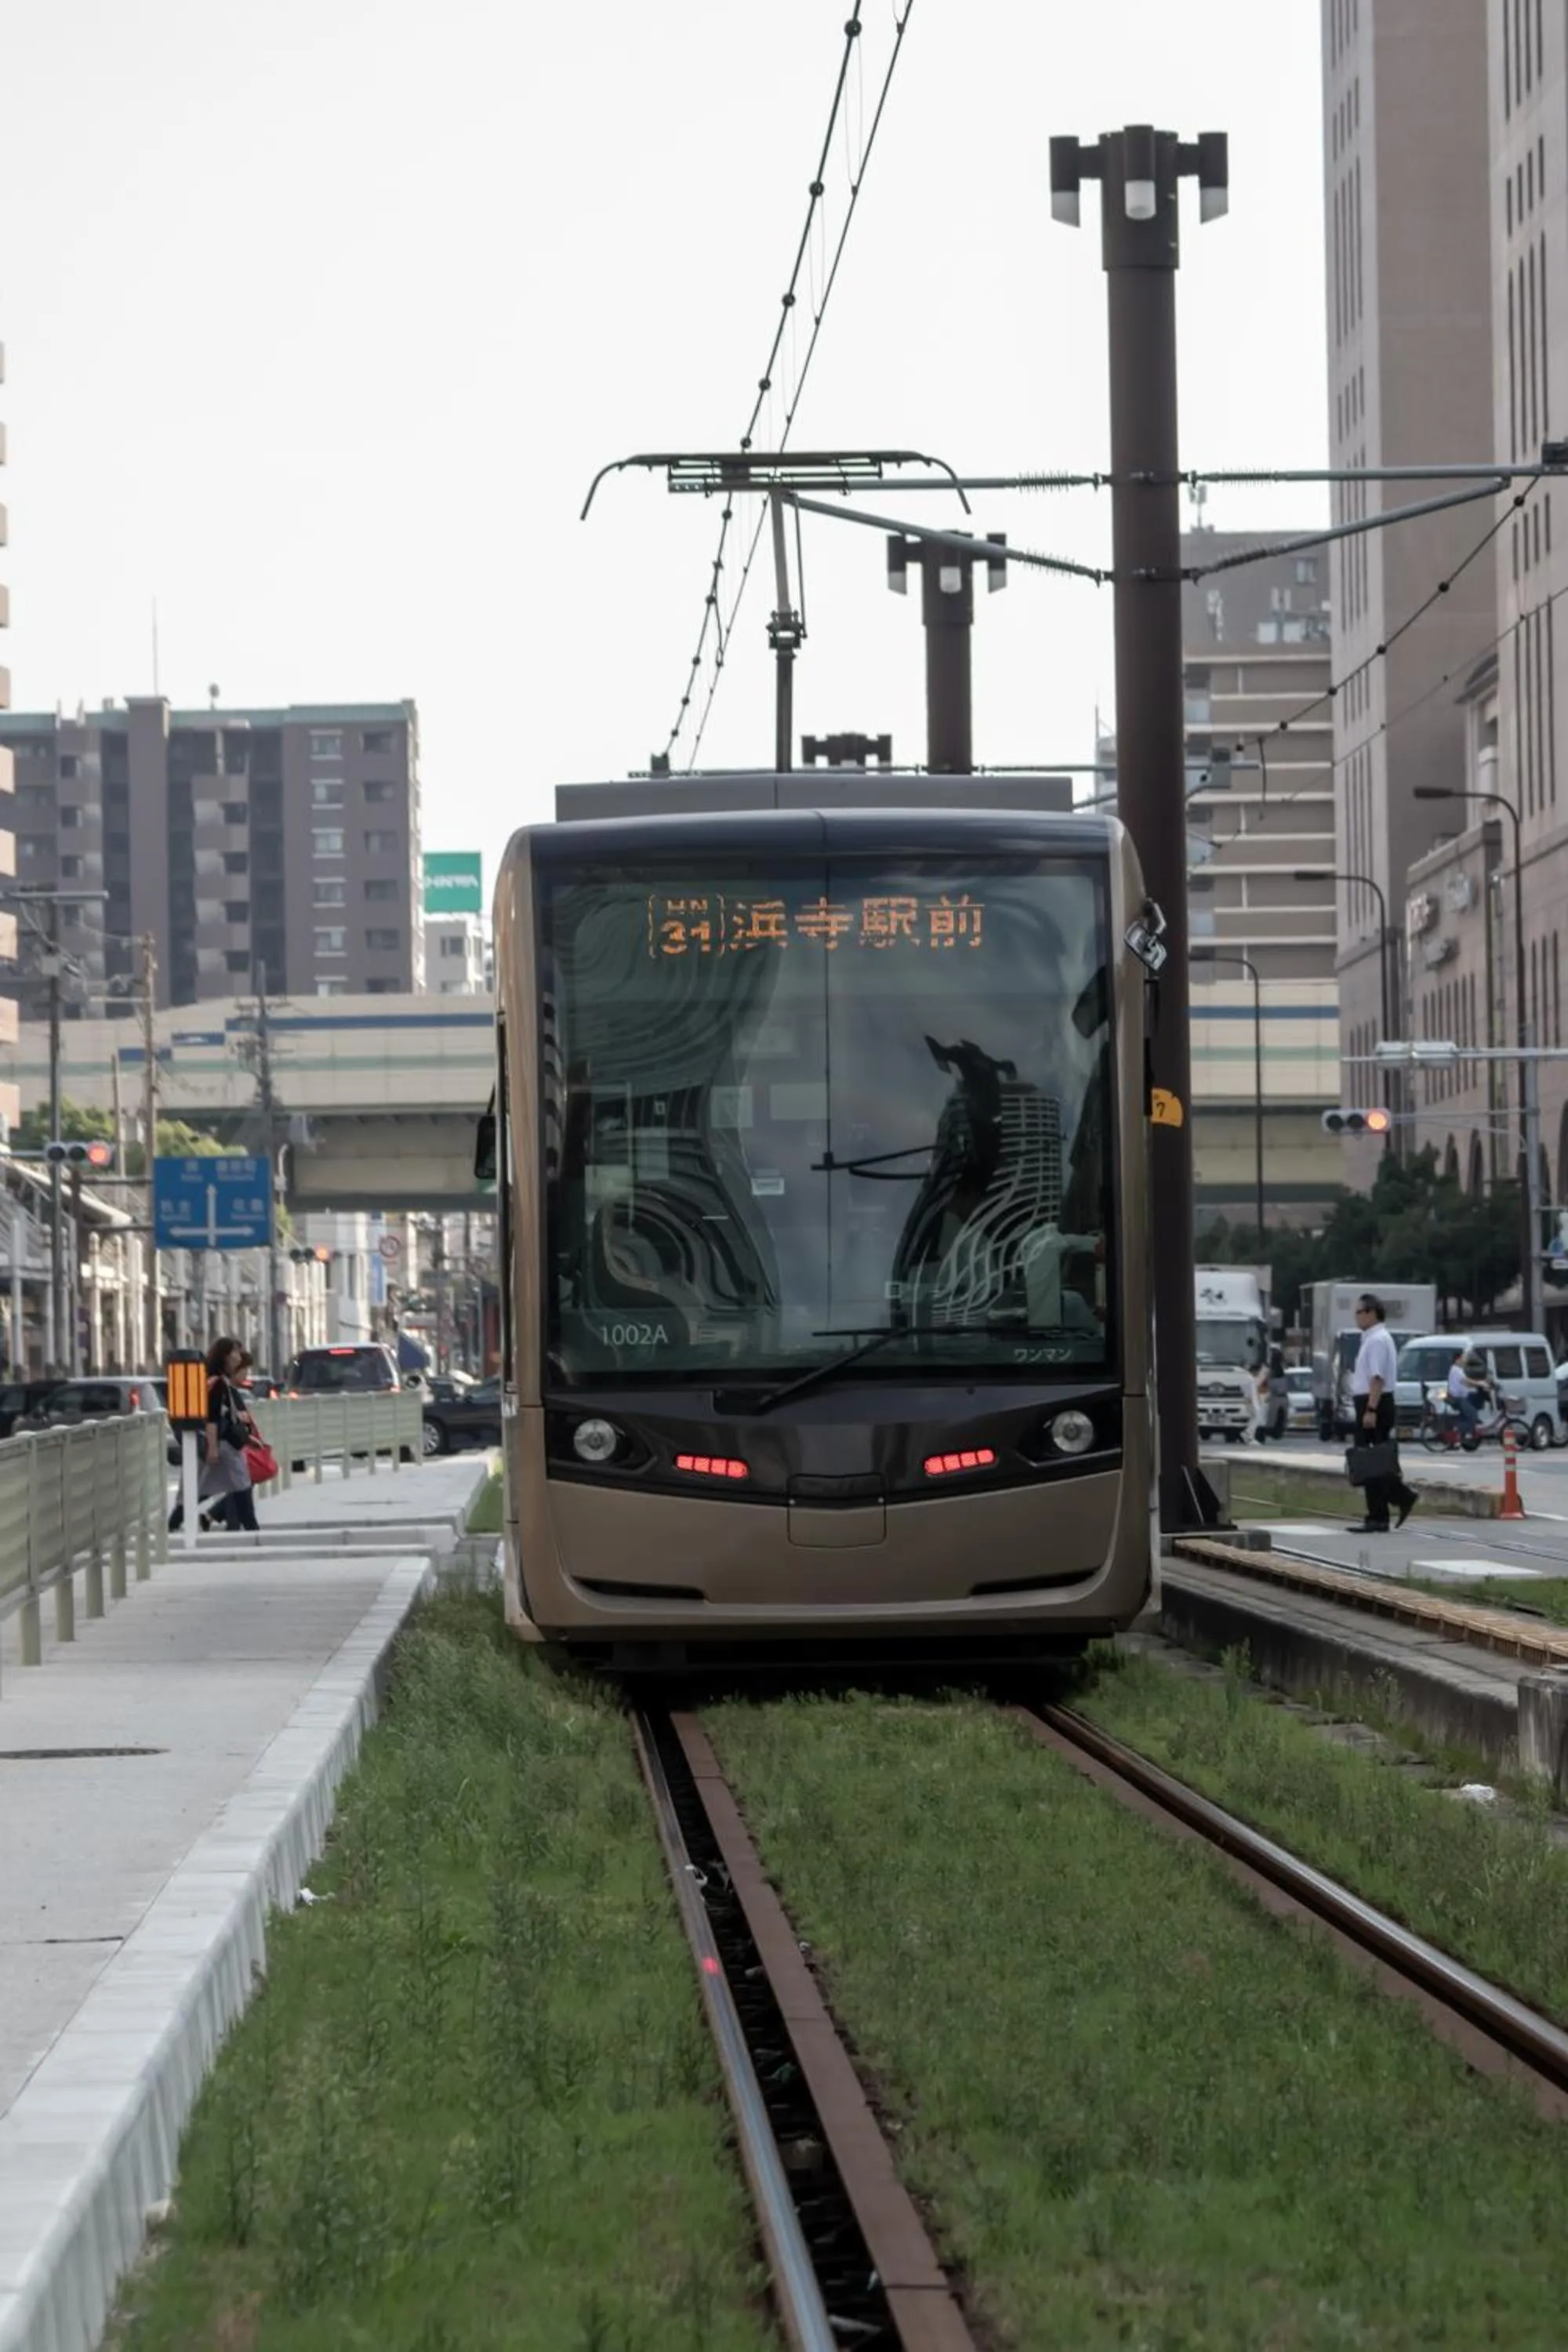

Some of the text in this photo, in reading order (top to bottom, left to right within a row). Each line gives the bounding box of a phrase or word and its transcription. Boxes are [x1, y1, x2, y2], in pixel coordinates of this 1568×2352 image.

[729, 894, 985, 949] 浜寺駅前
[661, 919, 711, 954] 31
[600, 1323, 669, 1346] 1002A
[1014, 1348, 1073, 1363] ワンマン
